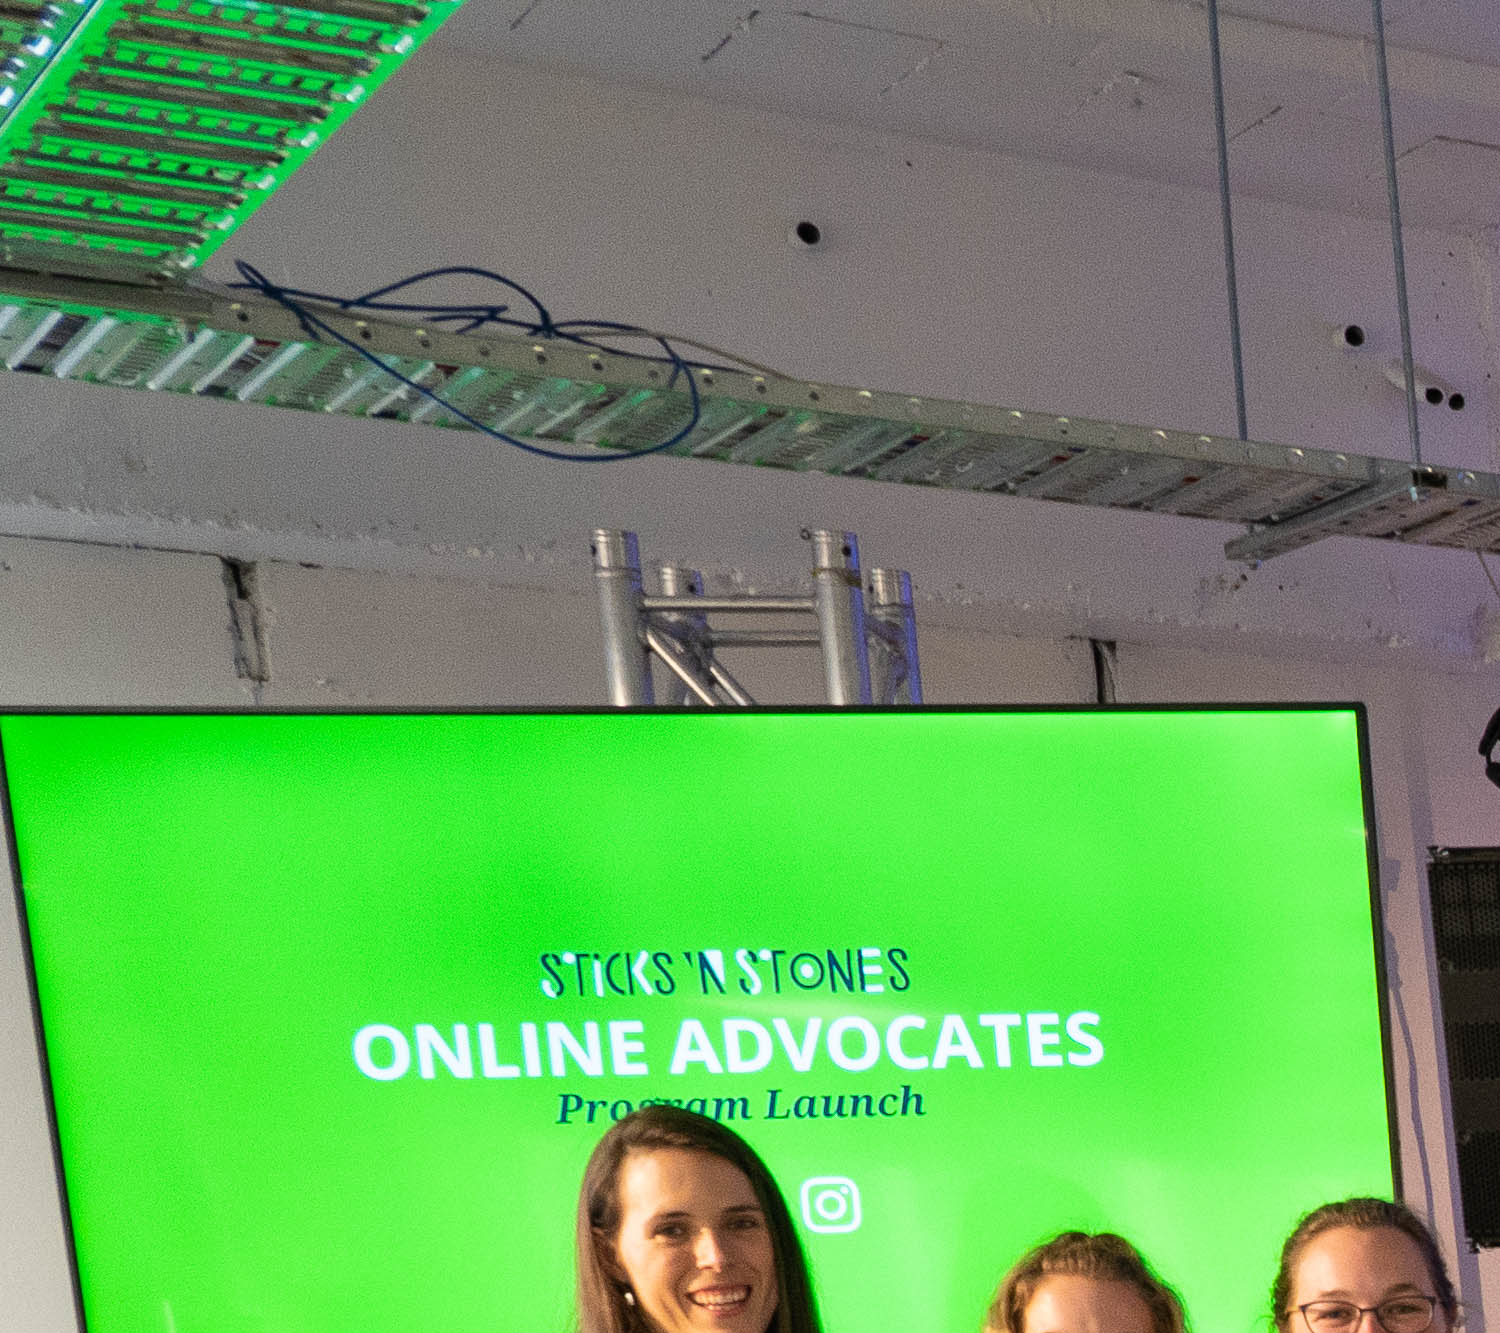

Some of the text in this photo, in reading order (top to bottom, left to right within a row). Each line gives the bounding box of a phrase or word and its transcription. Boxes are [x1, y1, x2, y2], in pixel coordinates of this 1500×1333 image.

[739, 947, 910, 995] STONES
[352, 1011, 1105, 1081] ONLINE ADVOCATES
[555, 1085, 926, 1124] Proam Launch
